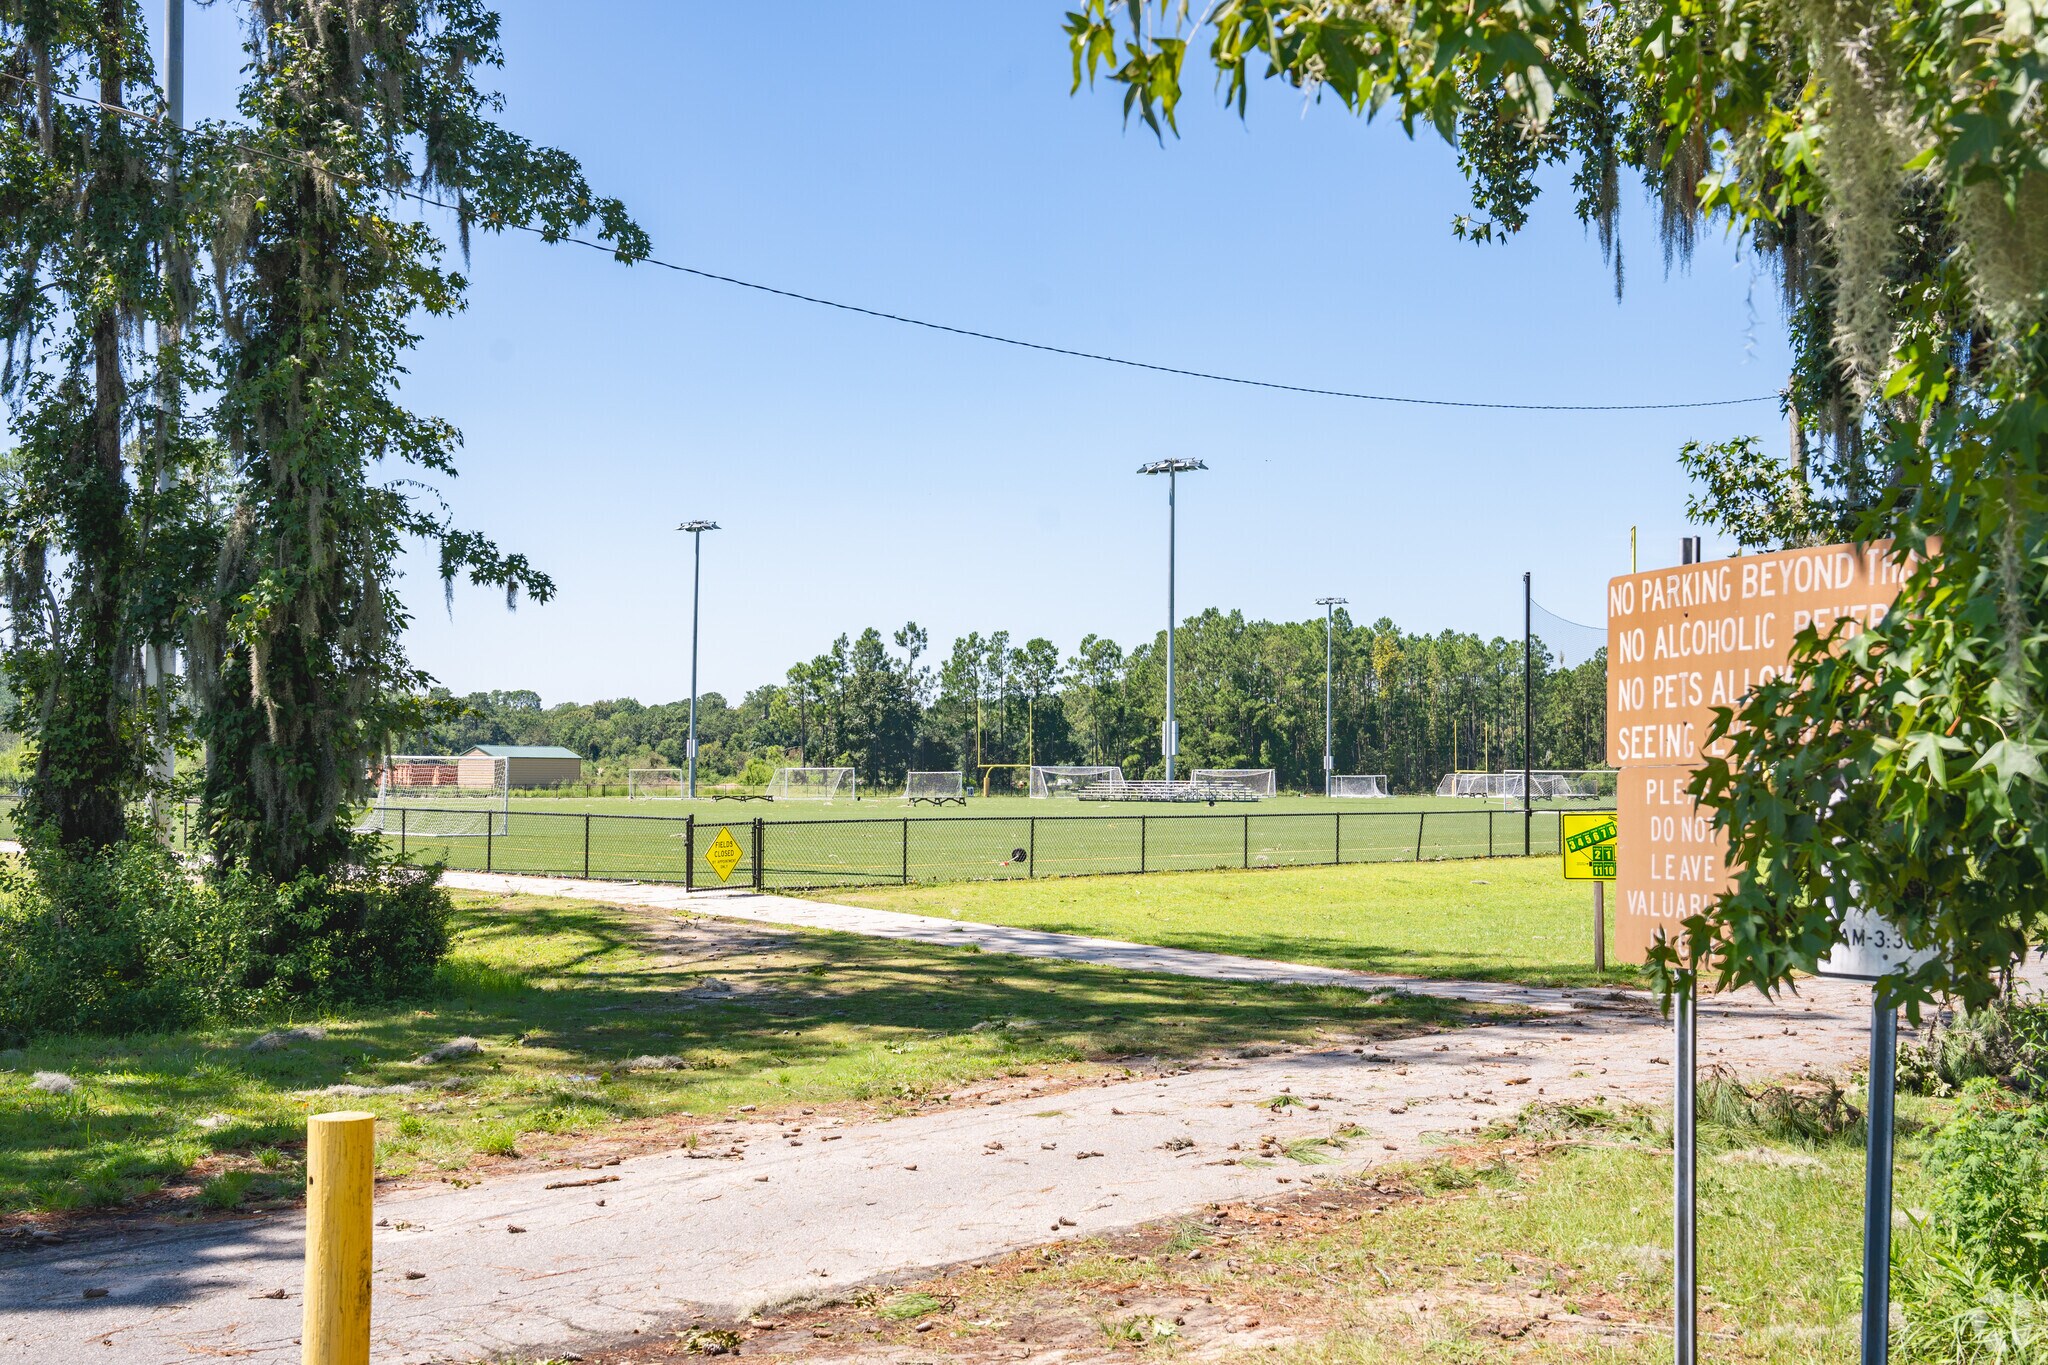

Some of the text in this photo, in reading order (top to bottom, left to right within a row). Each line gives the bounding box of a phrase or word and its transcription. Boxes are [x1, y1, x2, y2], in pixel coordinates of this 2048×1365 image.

[1610, 581, 1635, 618] NO
[1641, 565, 1731, 613] PARKING
[1742, 552, 1855, 600] BEYOND
[1619, 627, 1645, 664] NO
[1653, 612, 1775, 660] ALCOHOLIC
[1618, 676, 1644, 712] NO
[1653, 671, 1703, 710] PETS
[1617, 722, 1695, 761] SEEING
[1569, 841, 1576, 850] 3
[1584, 835, 1592, 844] 5
[1592, 832, 1600, 841] 6
[1601, 829, 1606, 838] 7
[1608, 826, 1616, 835] 8
[1650, 815, 1675, 843] DO
[1595, 851, 1611, 859] 2 1
[1651, 854, 1715, 883] LEAVE
[1594, 867, 1614, 875] 11 10
